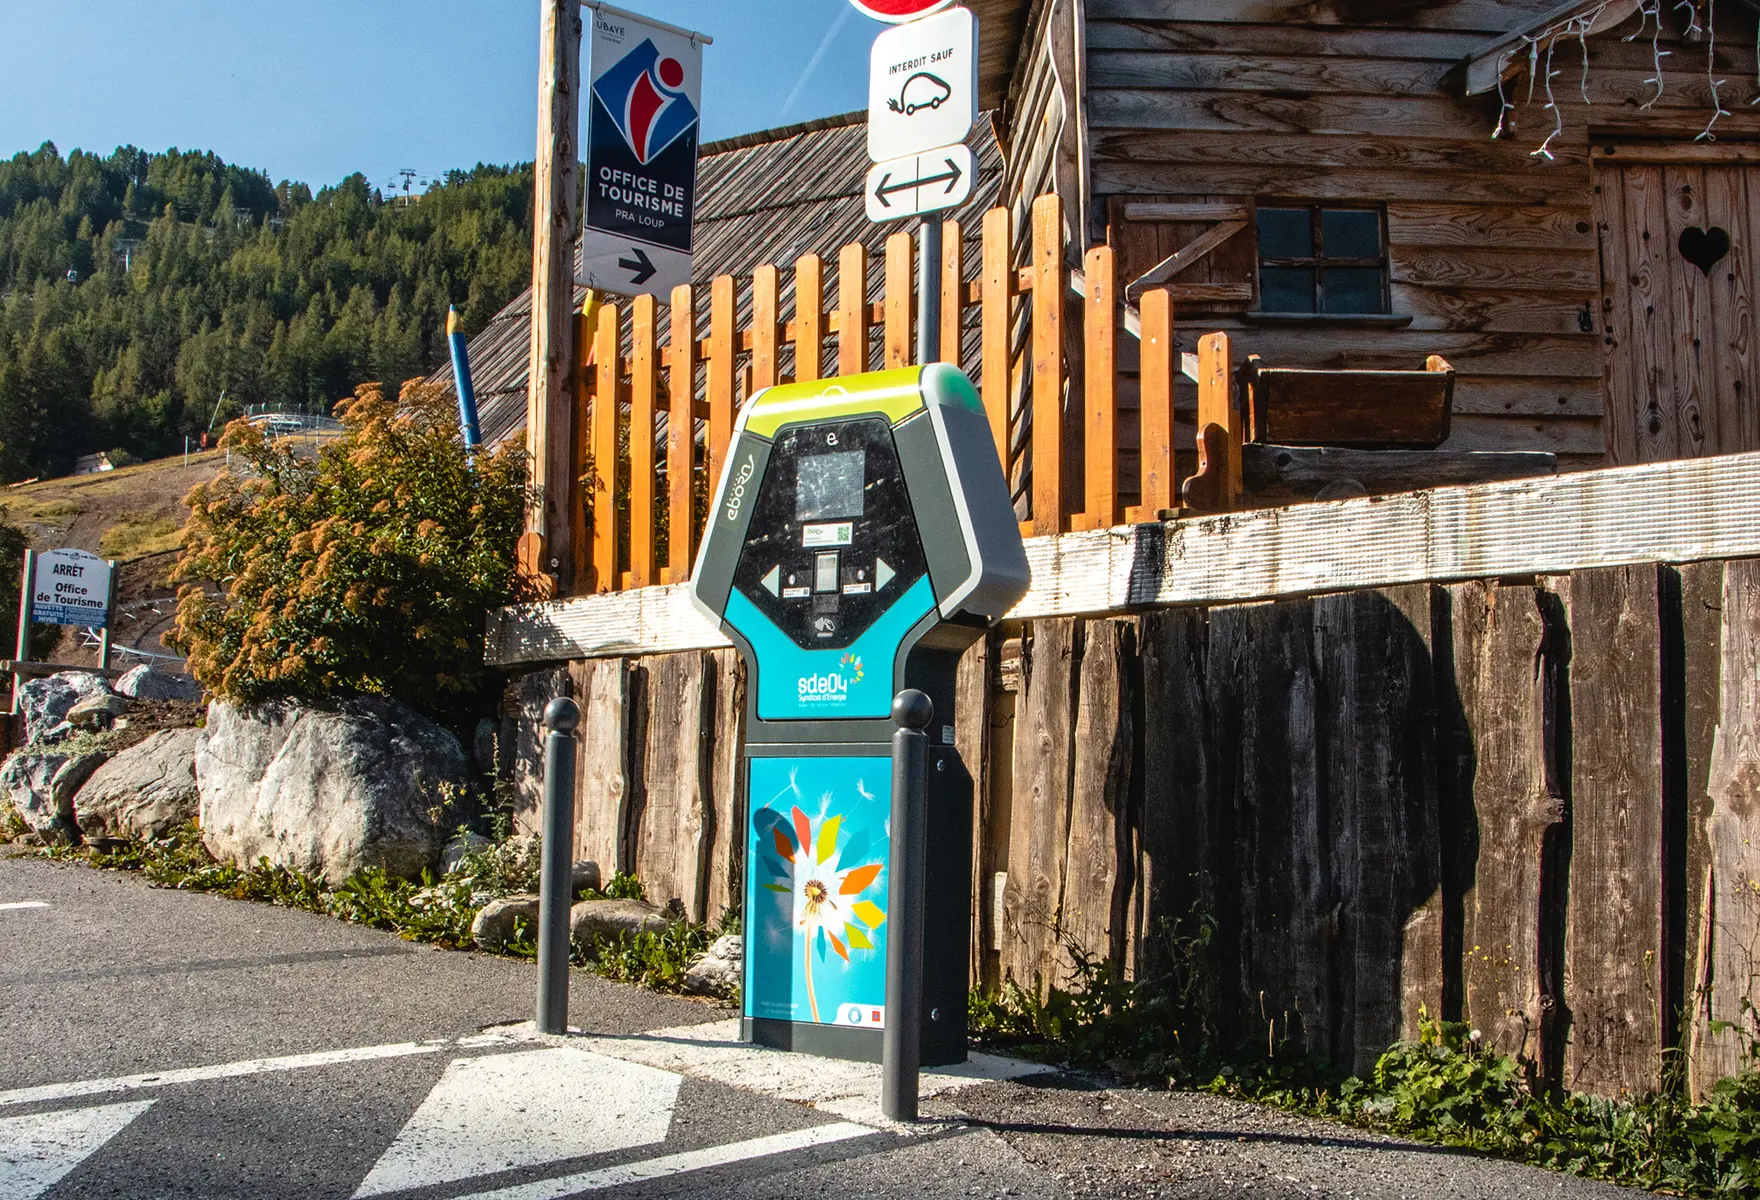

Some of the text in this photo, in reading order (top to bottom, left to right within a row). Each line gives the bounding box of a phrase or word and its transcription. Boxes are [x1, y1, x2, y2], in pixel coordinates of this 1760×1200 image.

[596, 20, 625, 37] UBAYE
[889, 47, 954, 75] INTERDIT SAUF
[600, 166, 685, 201] OFFICE DE
[599, 182, 684, 218] TOURISME
[615, 208, 665, 229] PRA LOUP
[53, 563, 84, 577] ARRÊT
[55, 582, 88, 595] Office
[34, 603, 63, 612] NAVETTE
[37, 592, 104, 608] de Tourisme
[33, 609, 65, 618] GRATUITE
[38, 615, 58, 623] HIVER
[797, 672, 848, 694] sde04
